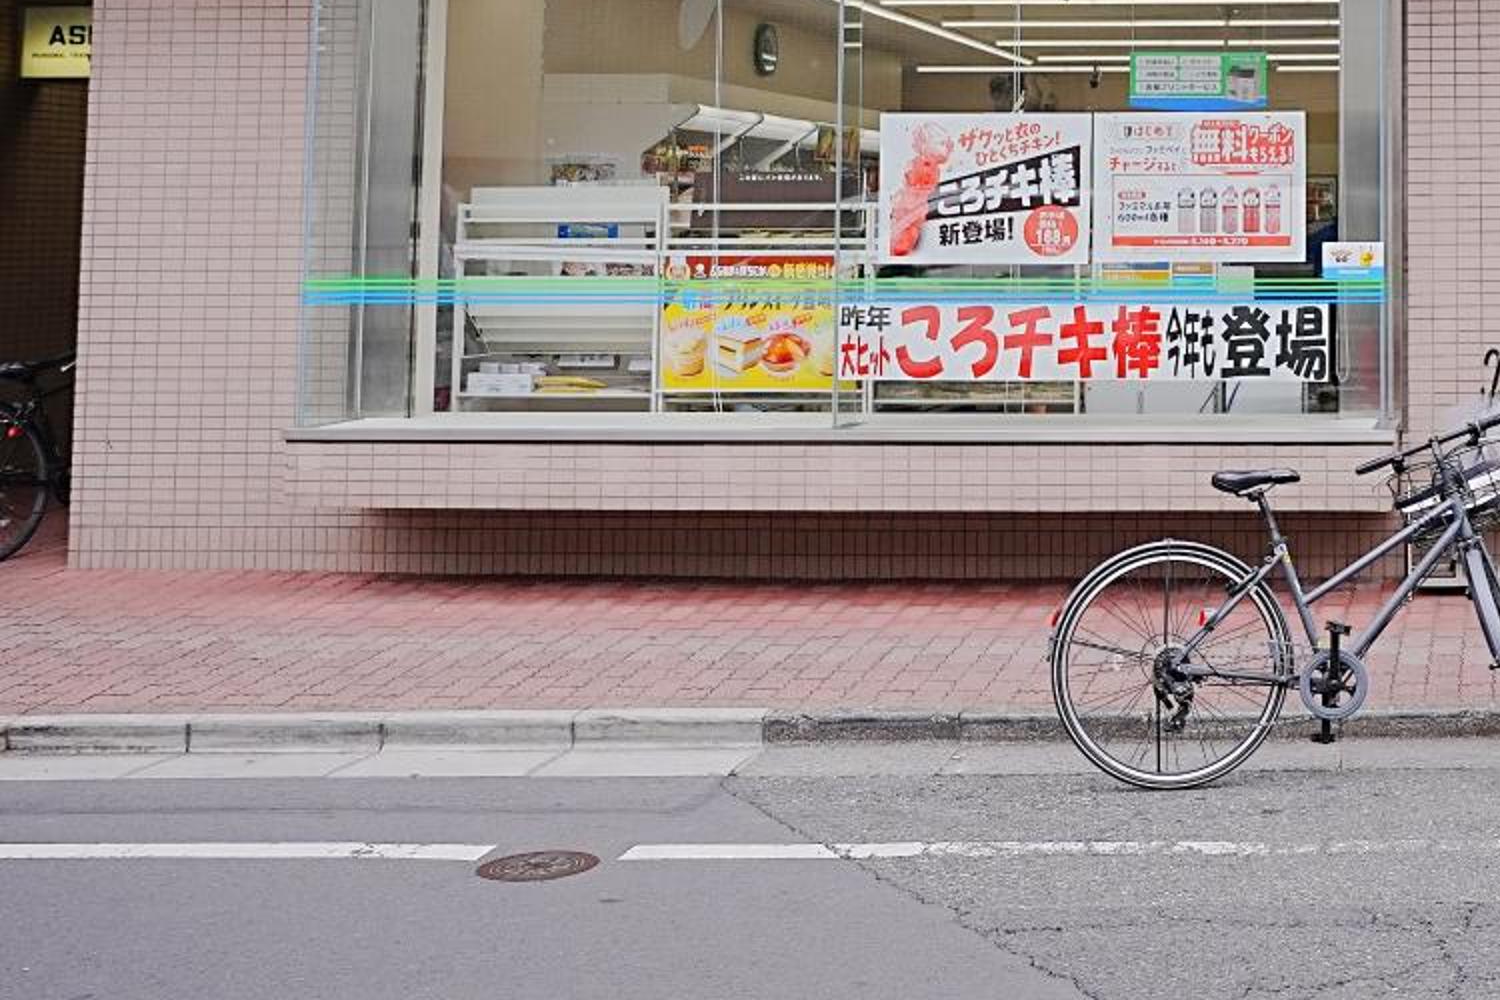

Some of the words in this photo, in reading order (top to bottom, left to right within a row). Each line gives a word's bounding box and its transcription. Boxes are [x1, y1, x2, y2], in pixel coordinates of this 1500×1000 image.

[958, 121, 1041, 152] ザクッと衣の
[975, 131, 1062, 166] ひとくちチキン!
[937, 152, 1076, 215] ころチキ棒
[939, 217, 1014, 246] 新登場!
[840, 306, 892, 331] 昨年
[840, 335, 891, 377] 大ヒット
[896, 305, 1162, 379] ころチキ棒
